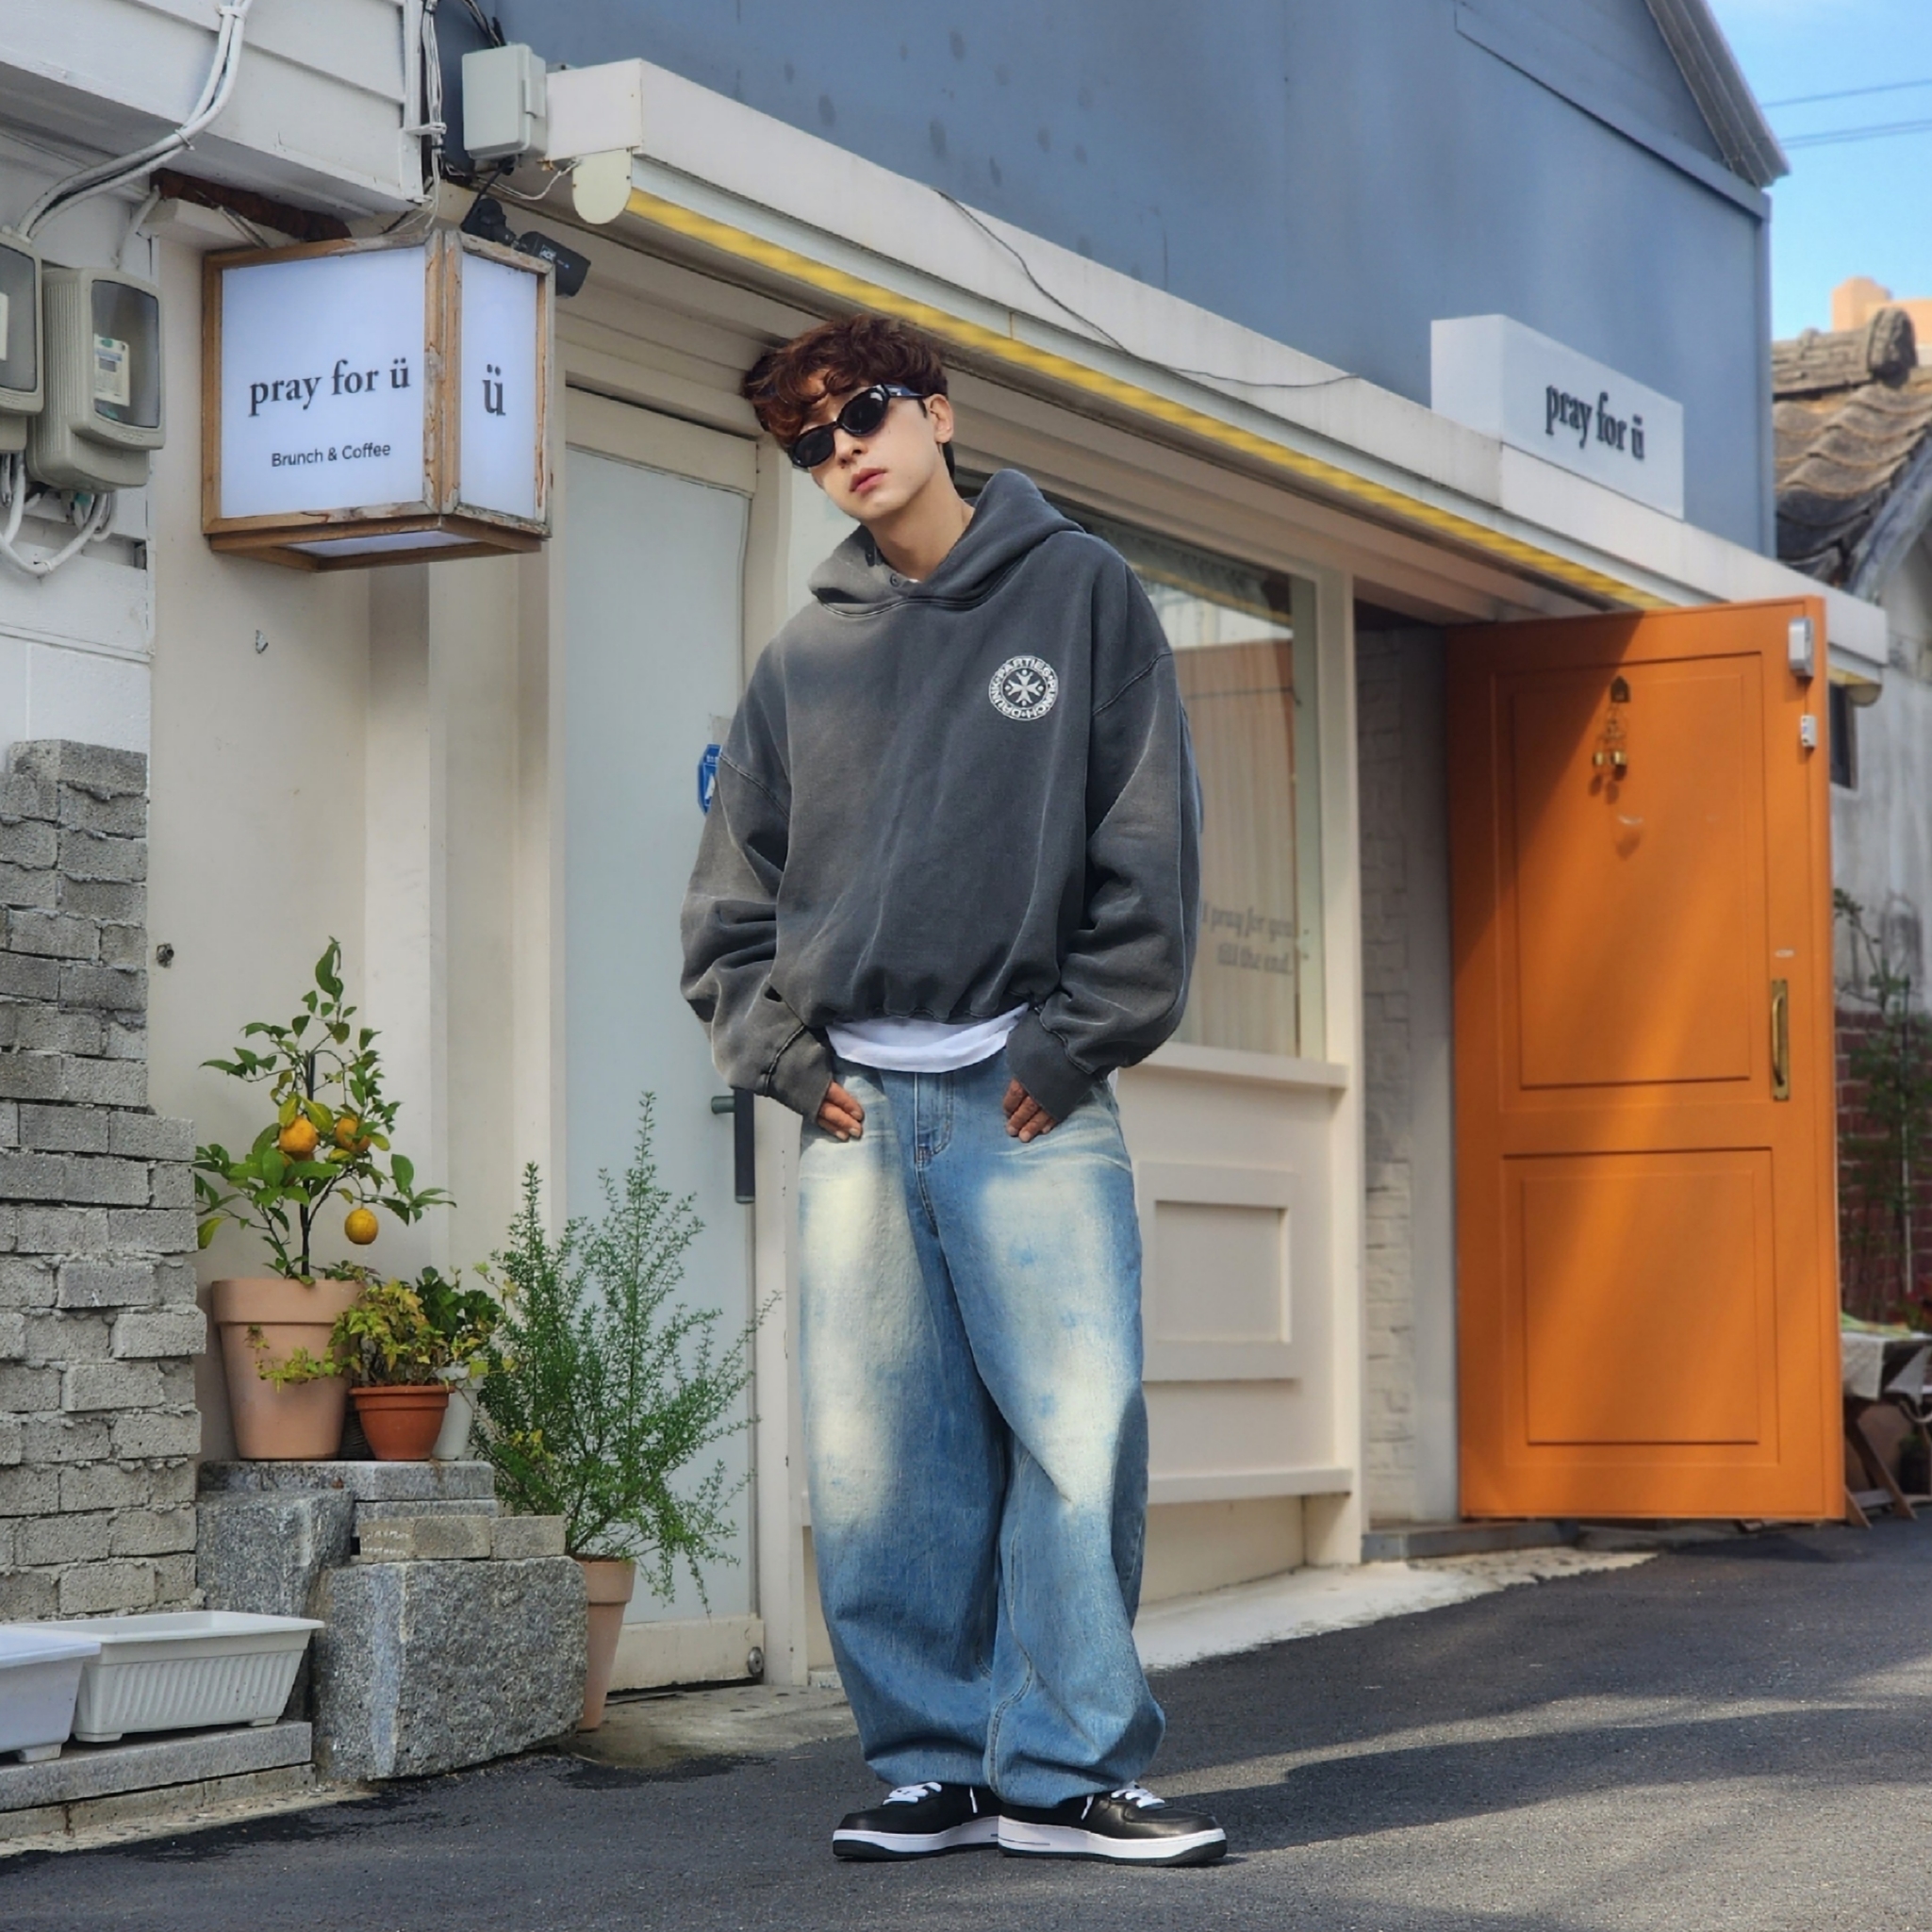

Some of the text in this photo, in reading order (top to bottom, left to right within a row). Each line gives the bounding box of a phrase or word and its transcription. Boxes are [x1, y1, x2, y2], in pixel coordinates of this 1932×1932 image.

[248, 357, 411, 417] pray for ü
[482, 363, 506, 416] ü
[1545, 385, 1593, 450] pray
[1596, 391, 1627, 451] for
[272, 442, 391, 467] Brunch & Coffee
